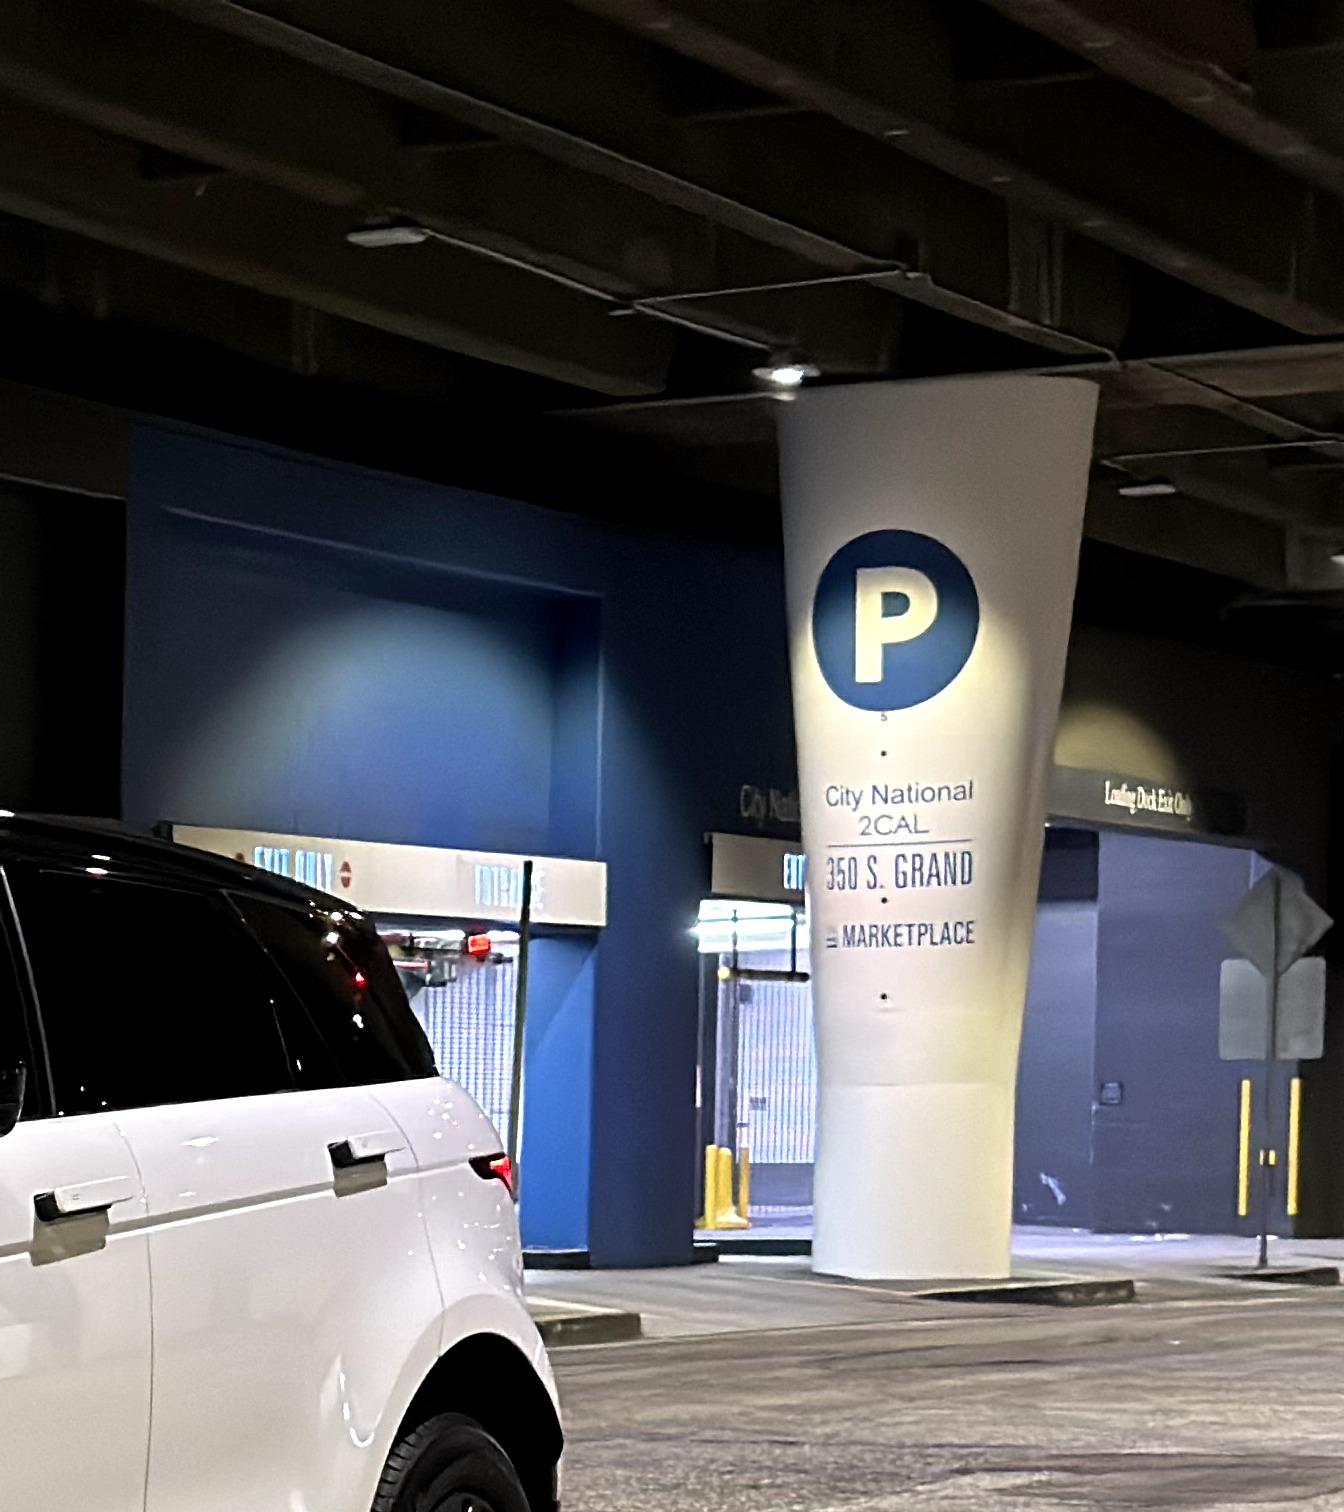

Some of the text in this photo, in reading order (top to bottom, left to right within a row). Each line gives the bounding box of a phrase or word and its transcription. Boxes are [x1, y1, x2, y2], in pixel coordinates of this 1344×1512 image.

[855, 566, 938, 684] P
[826, 779, 974, 812] City National
[858, 814, 930, 837] 2CAL
[826, 856, 858, 891] 350
[867, 855, 885, 890] S.
[895, 851, 973, 889] GRAND
[843, 921, 976, 949] MARKETPLACE
